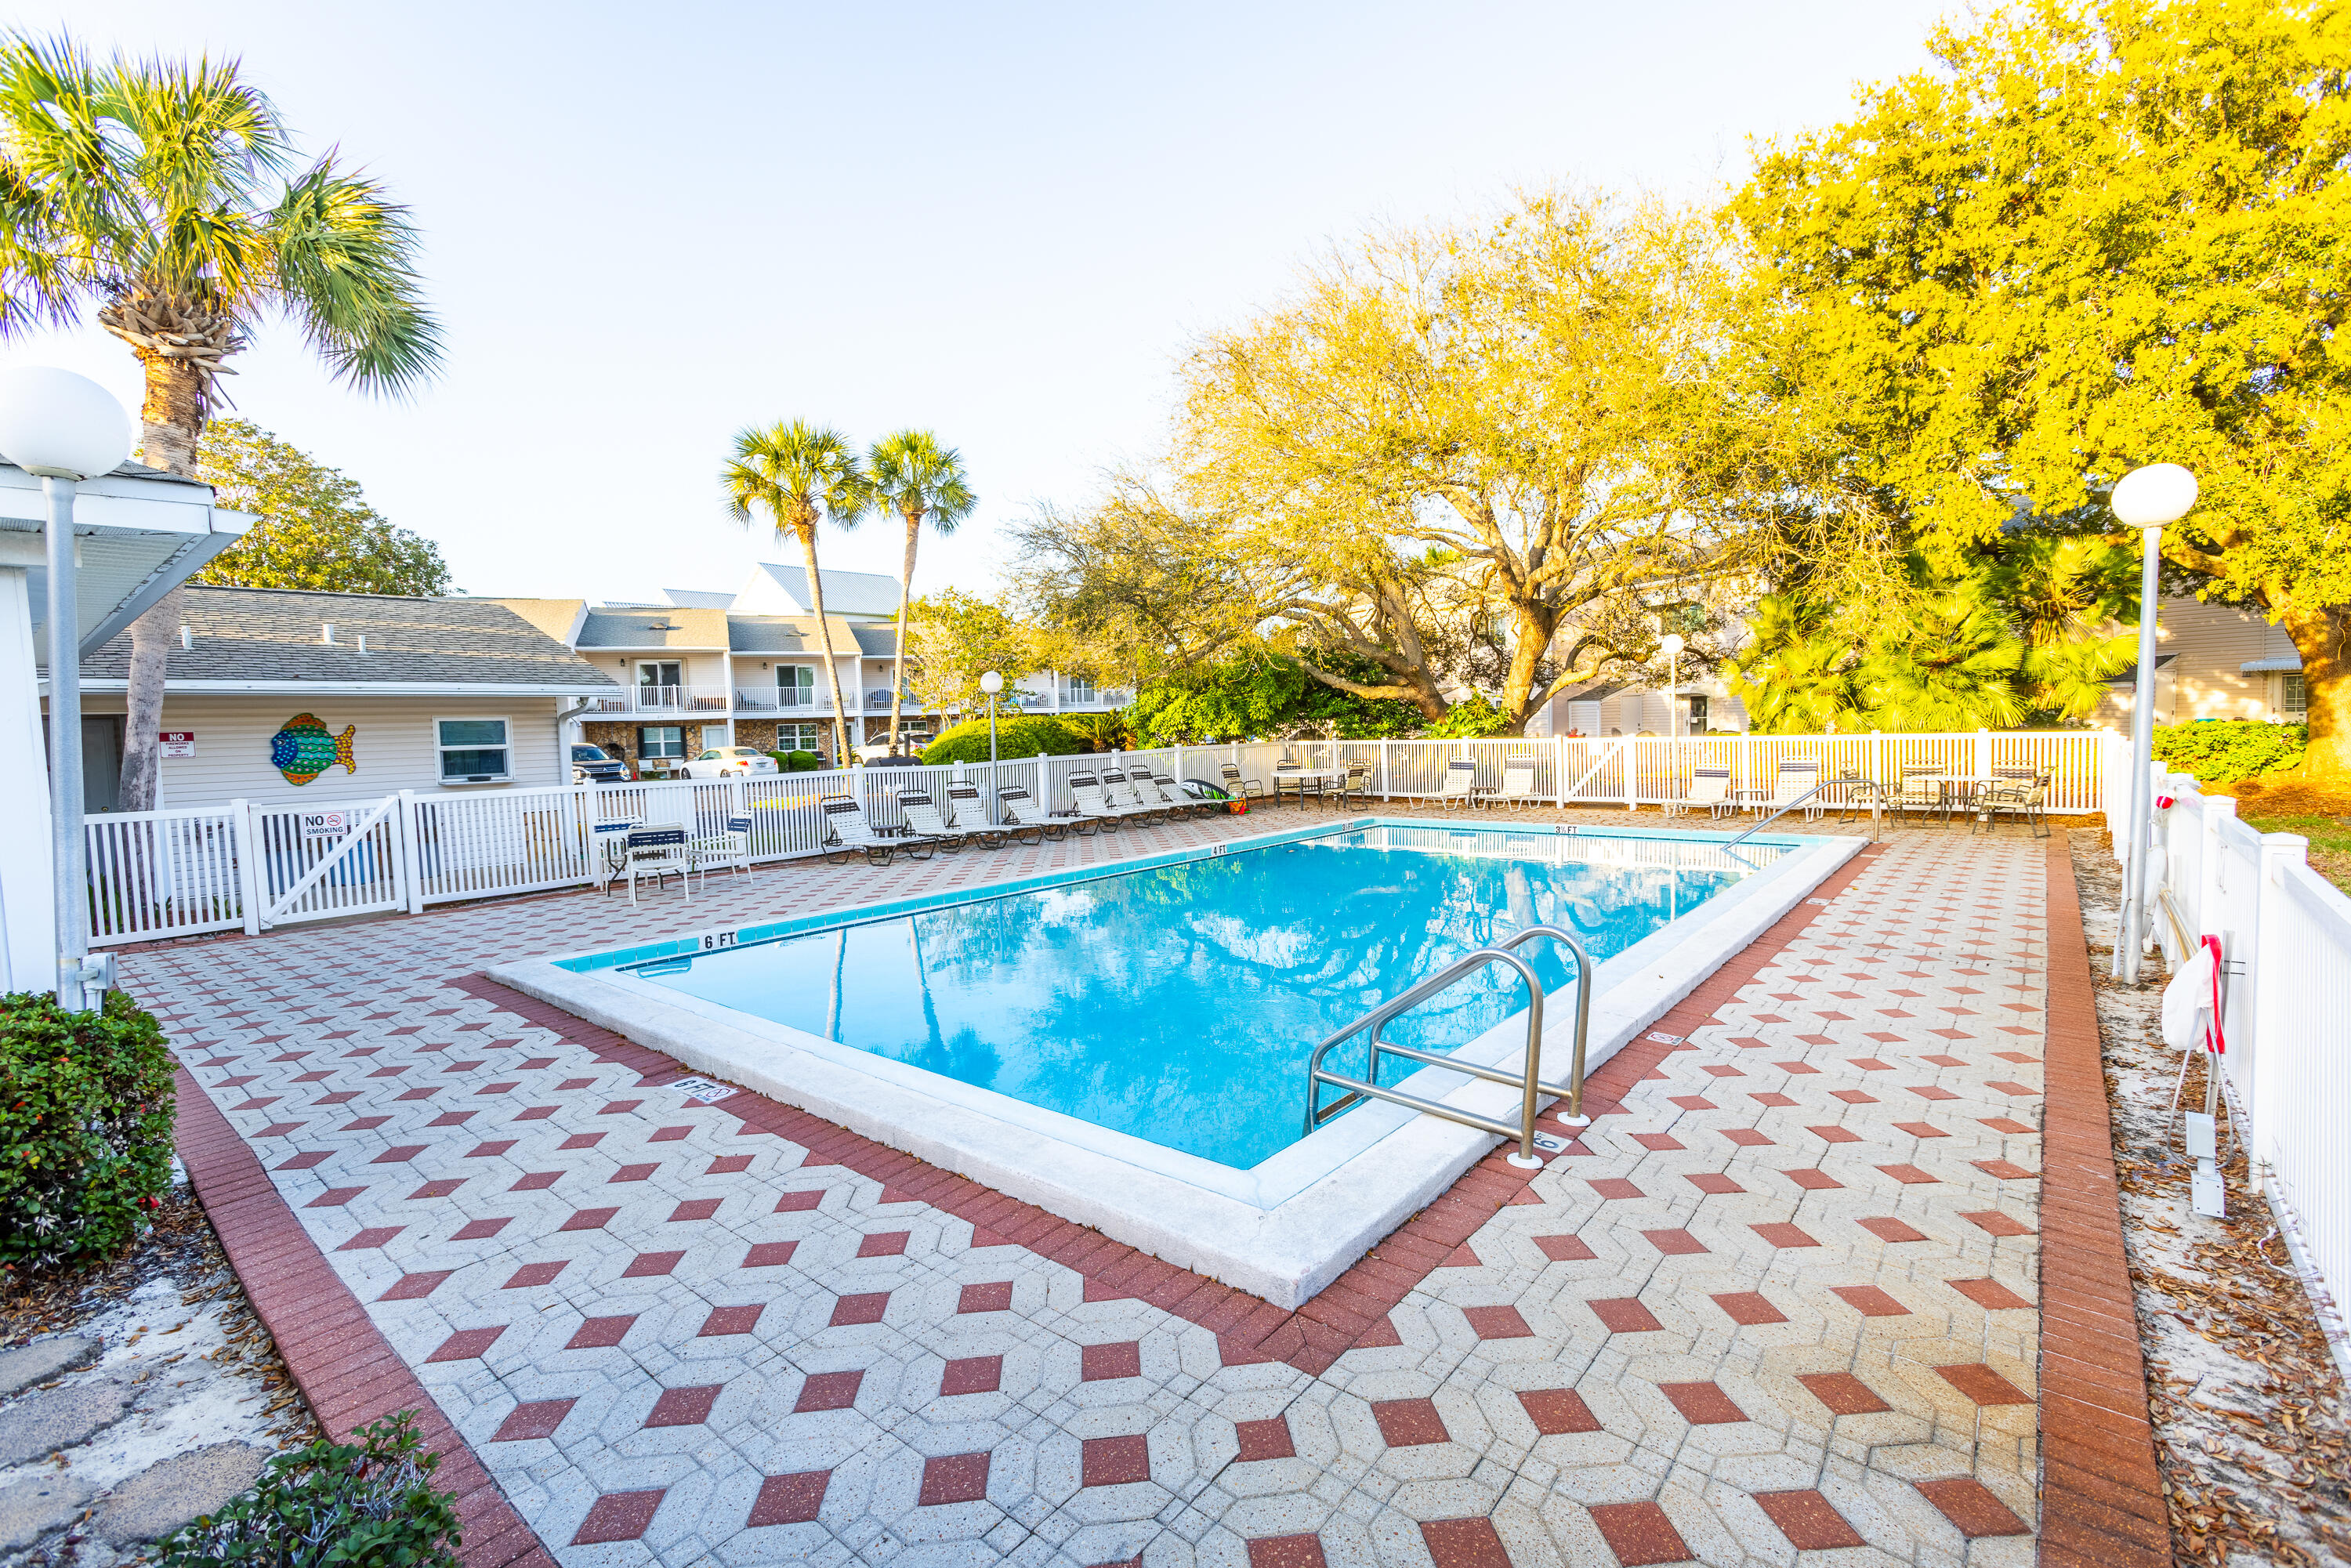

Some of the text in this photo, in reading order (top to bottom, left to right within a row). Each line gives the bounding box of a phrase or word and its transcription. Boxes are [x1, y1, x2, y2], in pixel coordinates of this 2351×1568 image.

[306, 816, 324, 827] NO
[306, 826, 343, 835] SMOKING
[1213, 844, 1226, 855] 4 FT
[705, 932, 736, 949] 6 FT.
[683, 1083, 716, 1094] FT
[1534, 1137, 1559, 1149] 6
